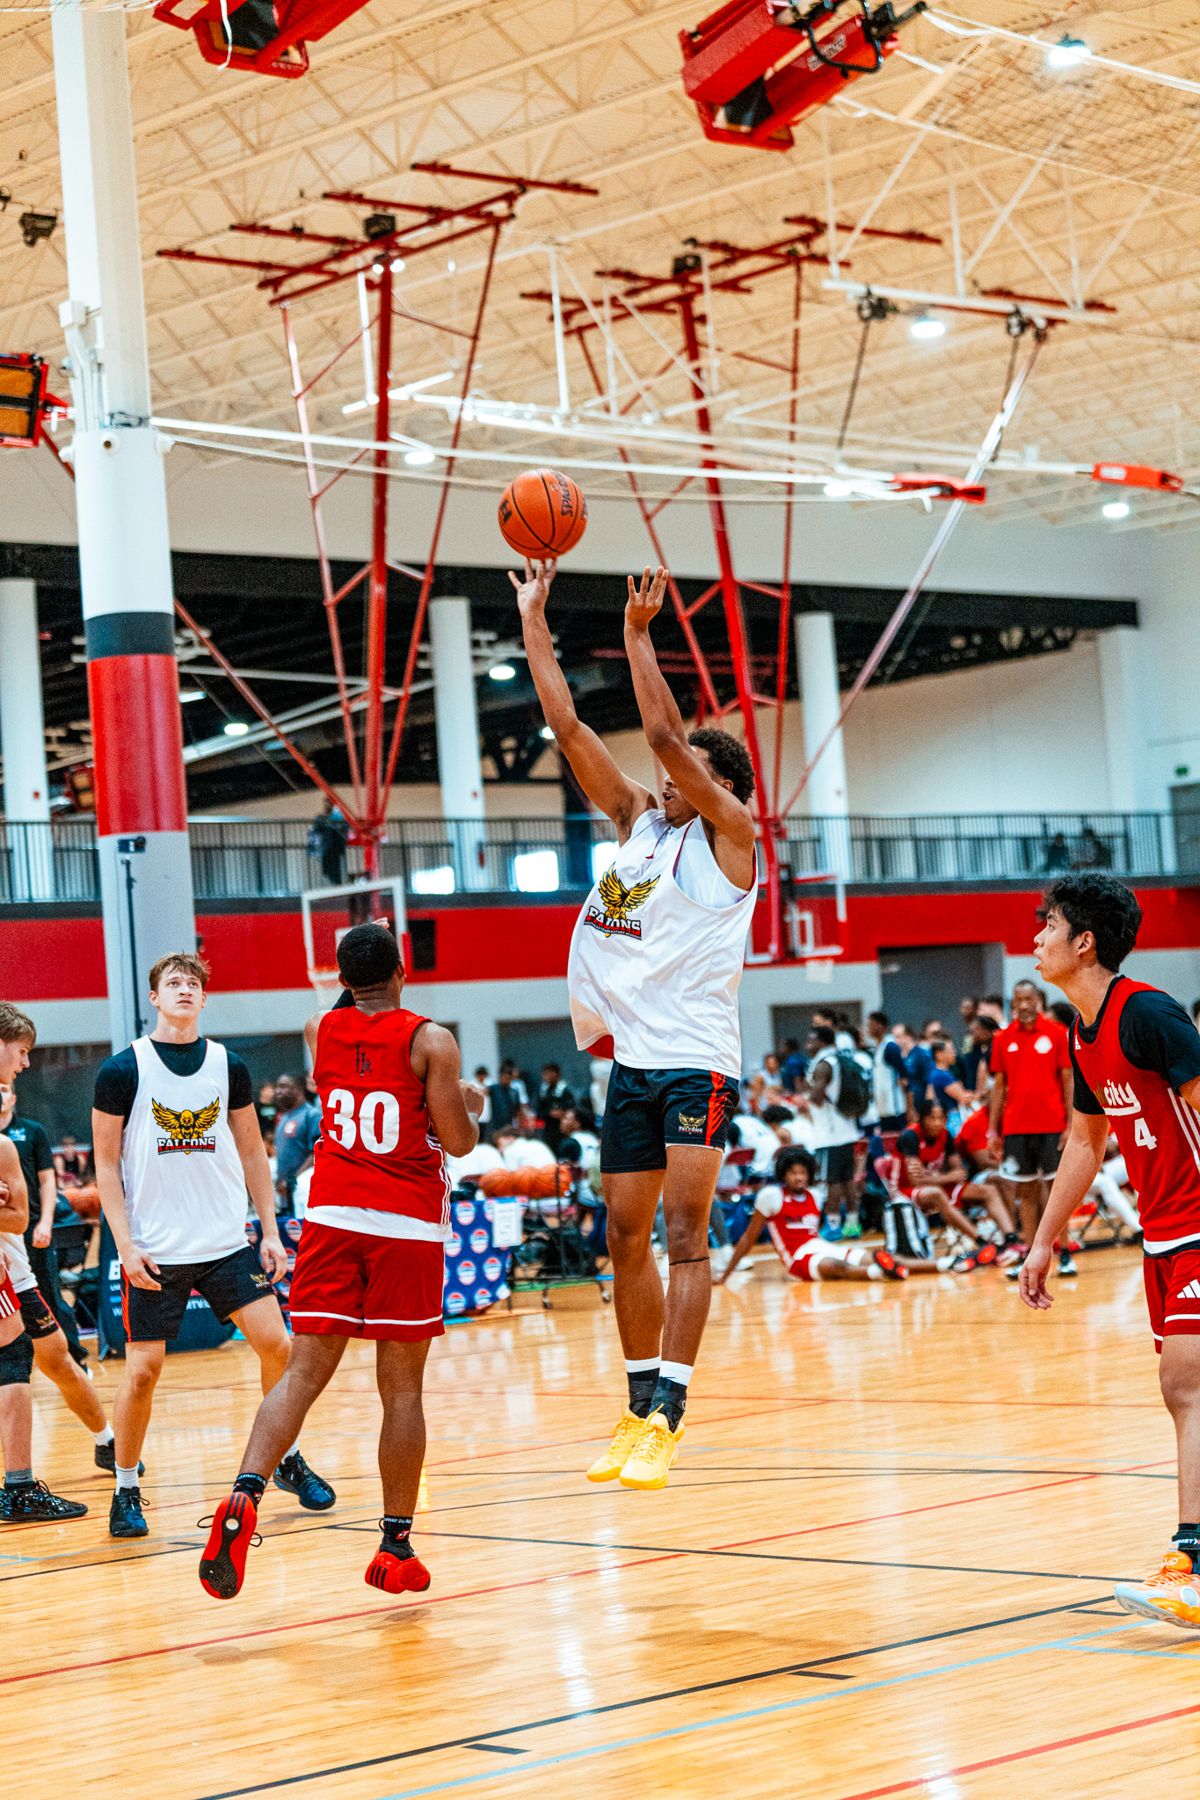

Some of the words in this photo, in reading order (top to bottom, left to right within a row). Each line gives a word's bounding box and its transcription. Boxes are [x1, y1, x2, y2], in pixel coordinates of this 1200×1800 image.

[326, 1088, 401, 1155] 30
[1134, 1117, 1158, 1151] 4
[157, 1136, 216, 1152] FALCONS
